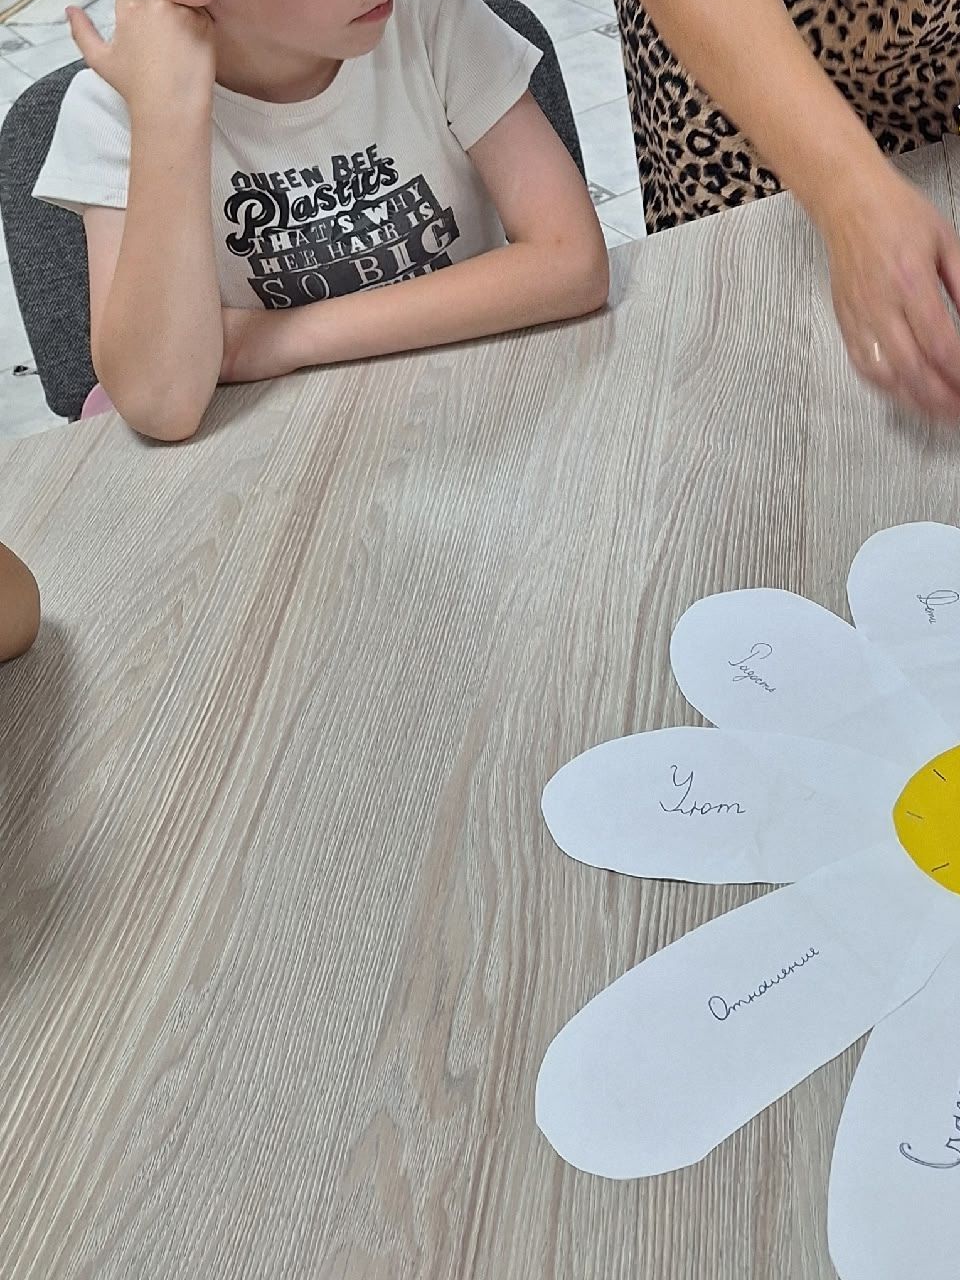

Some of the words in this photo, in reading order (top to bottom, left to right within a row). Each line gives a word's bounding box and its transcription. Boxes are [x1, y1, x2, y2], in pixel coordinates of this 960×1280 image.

[231, 166, 325, 191] QUEEN
[331, 143, 381, 181] BEE
[224, 156, 399, 257] Plastics
[249, 216, 354, 255] THAT'S
[362, 179, 424, 226] WHY
[259, 250, 318, 276] HER
[328, 222, 402, 260] HAIR
[406, 200, 435, 228] IS
[262, 271, 330, 310] SO
[349, 218, 451, 286] BIG
[728, 642, 777, 693] Радость
[659, 764, 746, 817] Уют
